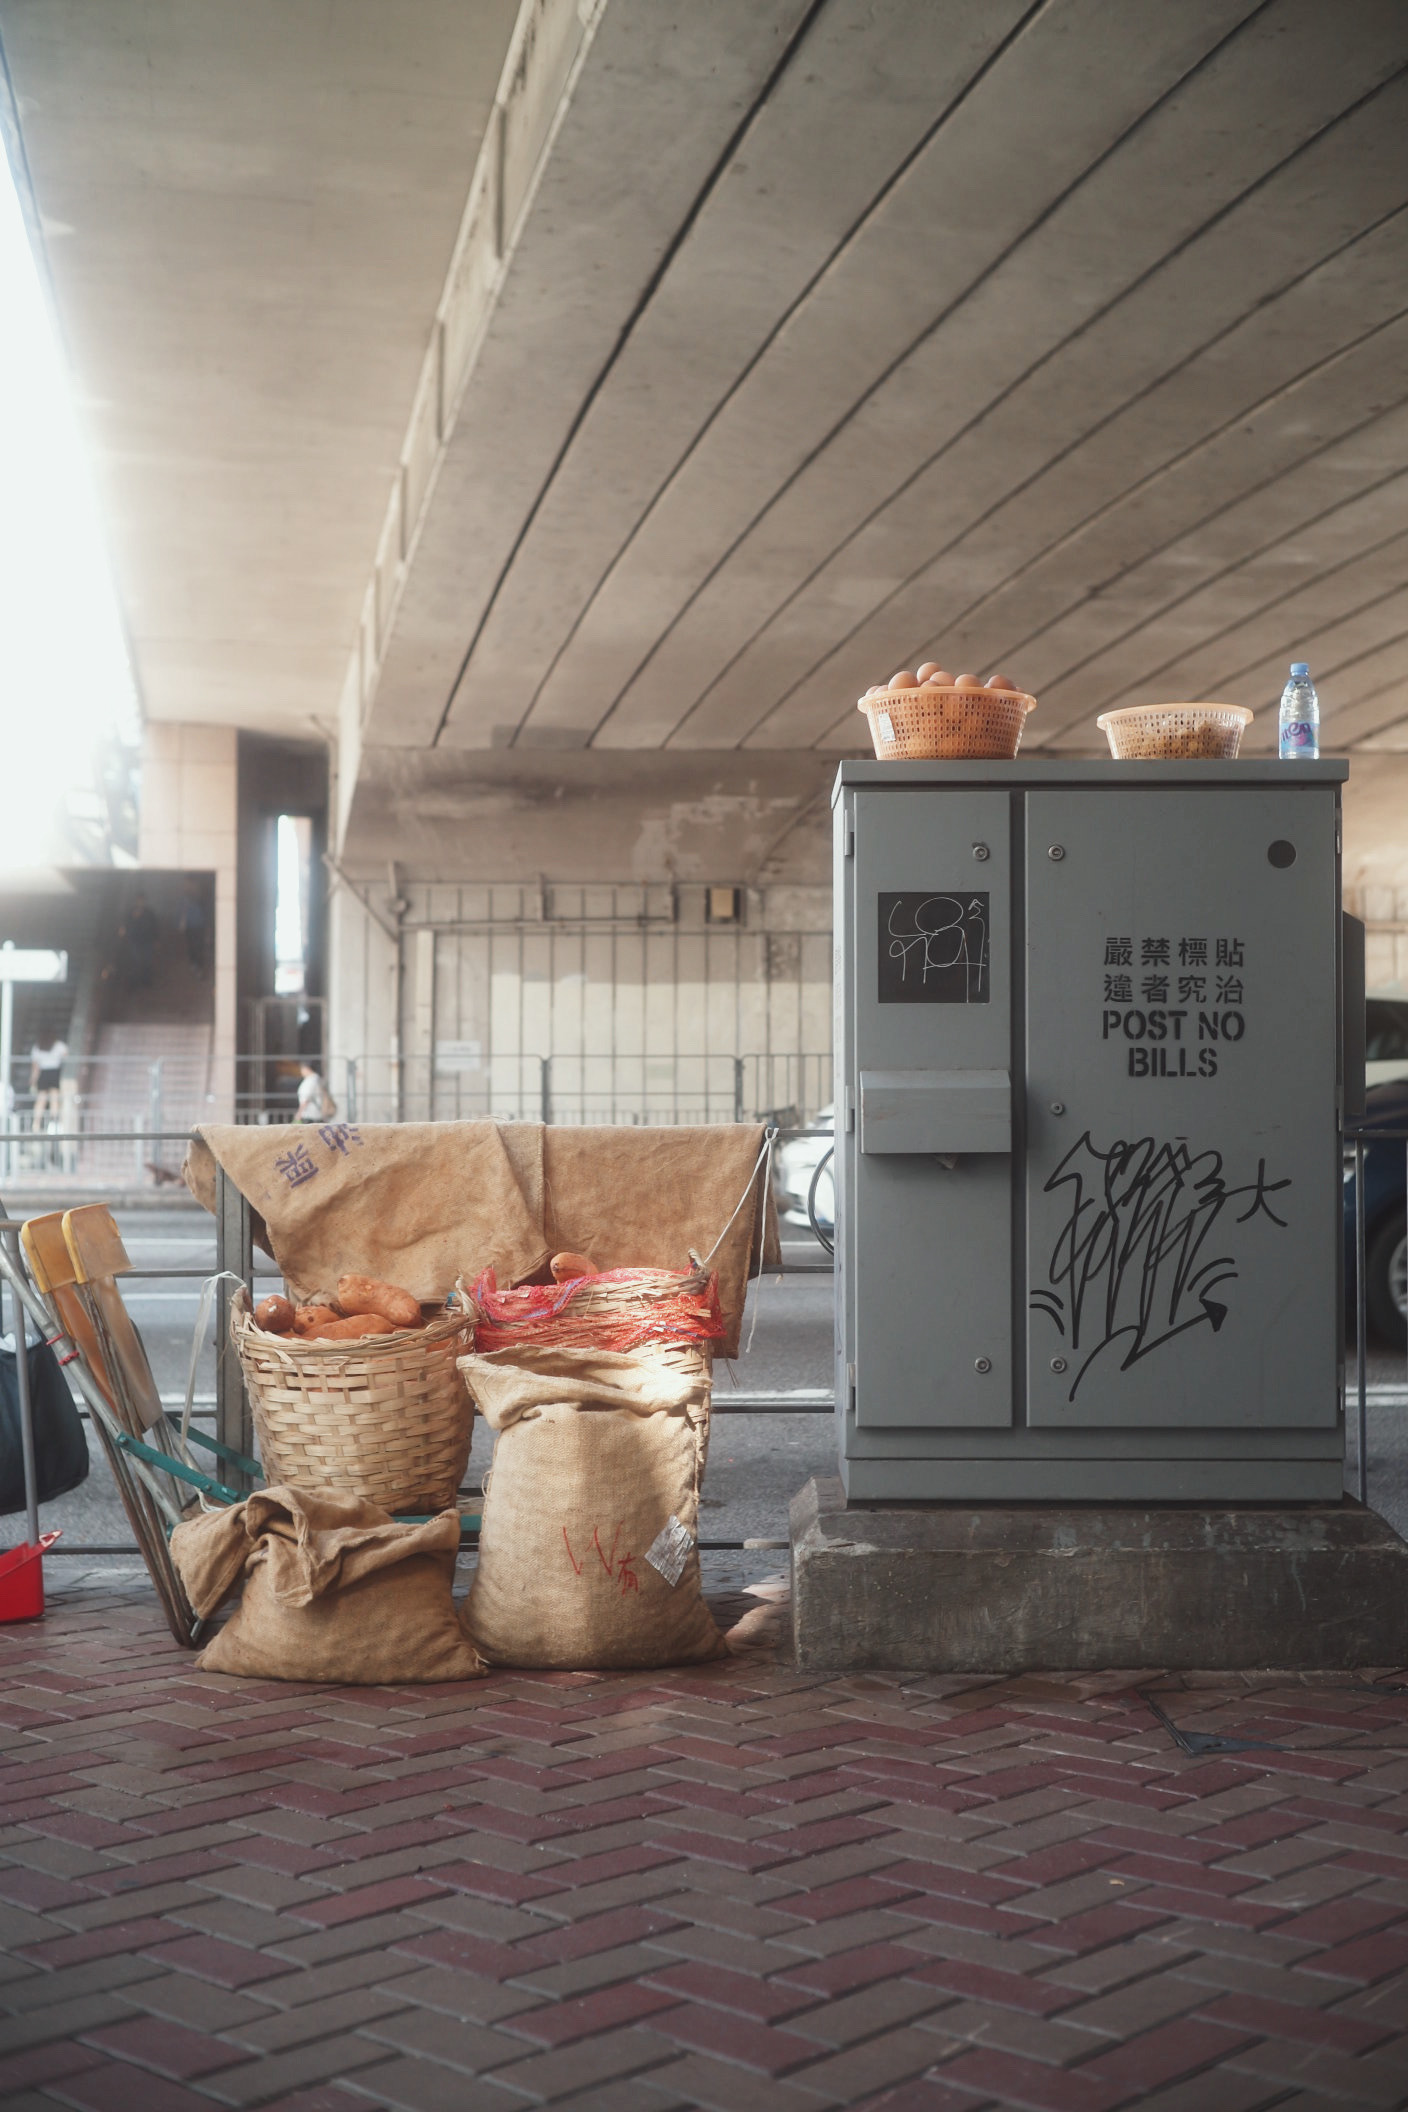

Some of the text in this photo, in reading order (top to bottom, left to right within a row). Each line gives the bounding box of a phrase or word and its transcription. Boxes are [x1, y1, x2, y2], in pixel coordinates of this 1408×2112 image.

[1104, 937, 1245, 967] 嚴禁標貼
[1104, 974, 1244, 1004] 違者究治
[1103, 1010, 1245, 1041] POST NO
[1128, 1048, 1218, 1077] BILLS
